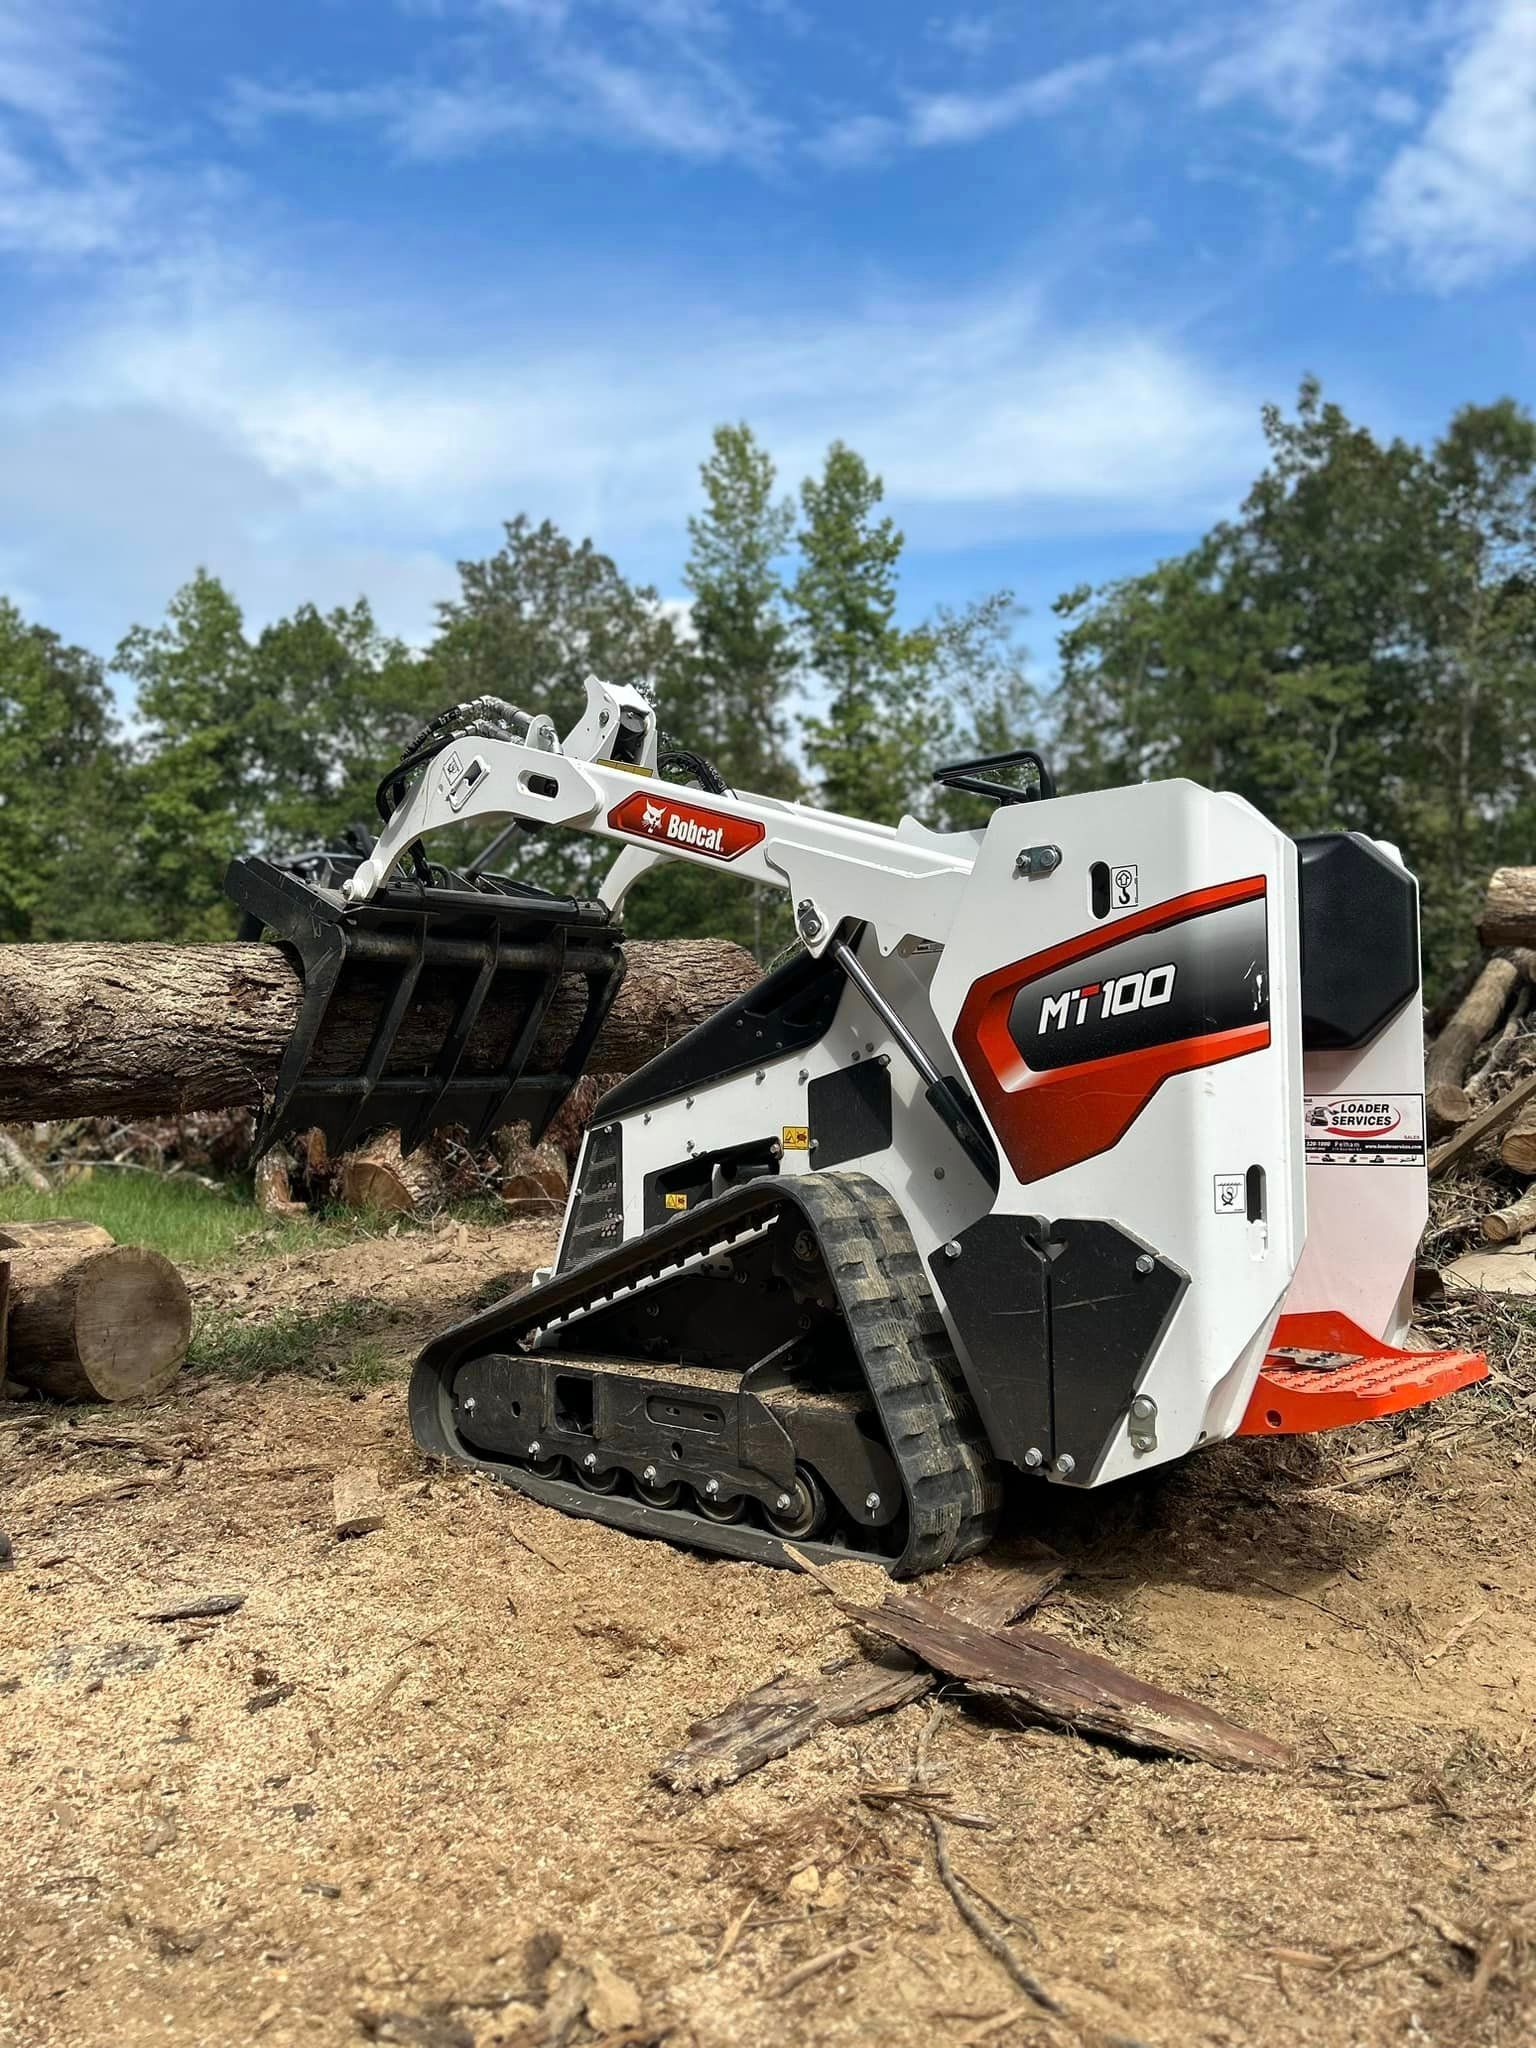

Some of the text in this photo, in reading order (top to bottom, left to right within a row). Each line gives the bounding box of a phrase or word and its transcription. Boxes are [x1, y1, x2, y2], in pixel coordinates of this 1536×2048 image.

[667, 814, 722, 852] Bobcat
[1037, 963, 1177, 1035] MT100
[1331, 1115, 1392, 1126] SERVICES
[1340, 1103, 1390, 1114] LOADER
